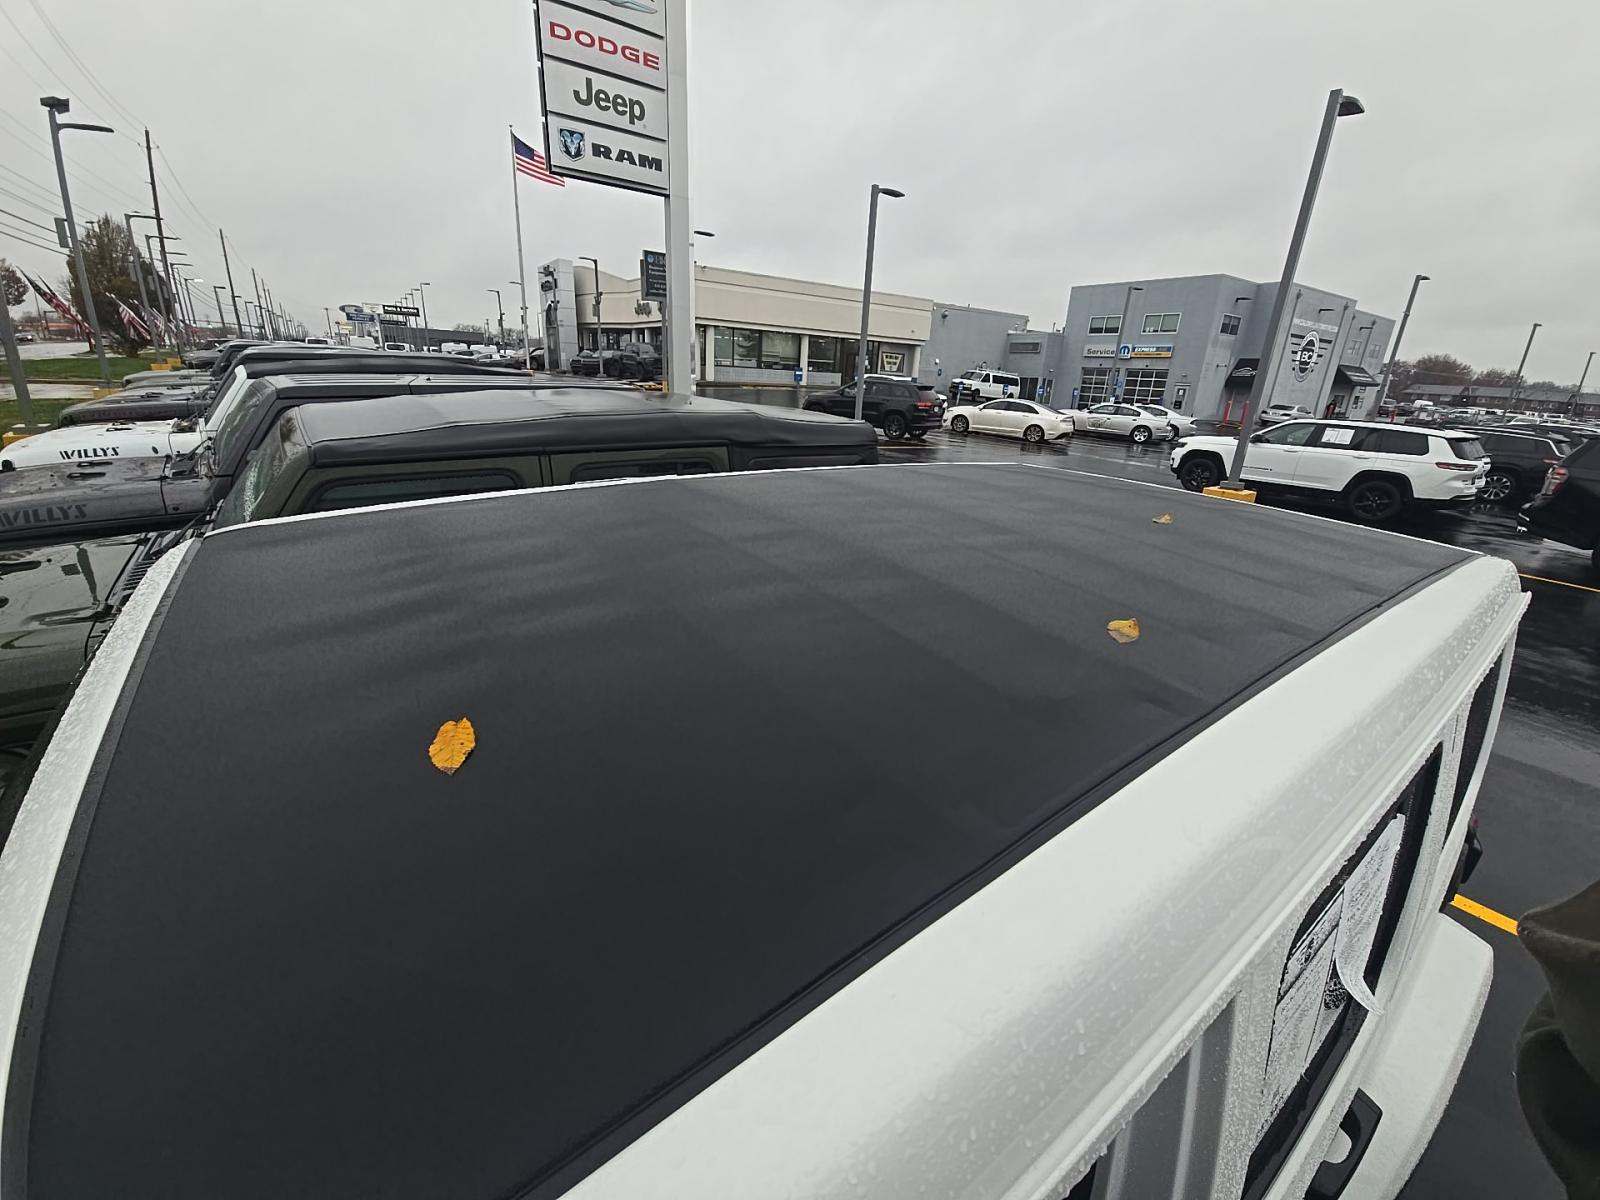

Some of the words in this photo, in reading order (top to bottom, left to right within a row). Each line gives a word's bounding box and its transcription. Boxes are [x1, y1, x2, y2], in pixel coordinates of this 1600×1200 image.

[549, 21, 660, 71] DODGE
[572, 77, 646, 125] Jeep
[591, 142, 663, 172] RAM
[59, 446, 120, 460] WILLYS
[0, 504, 88, 527] WILLYS
